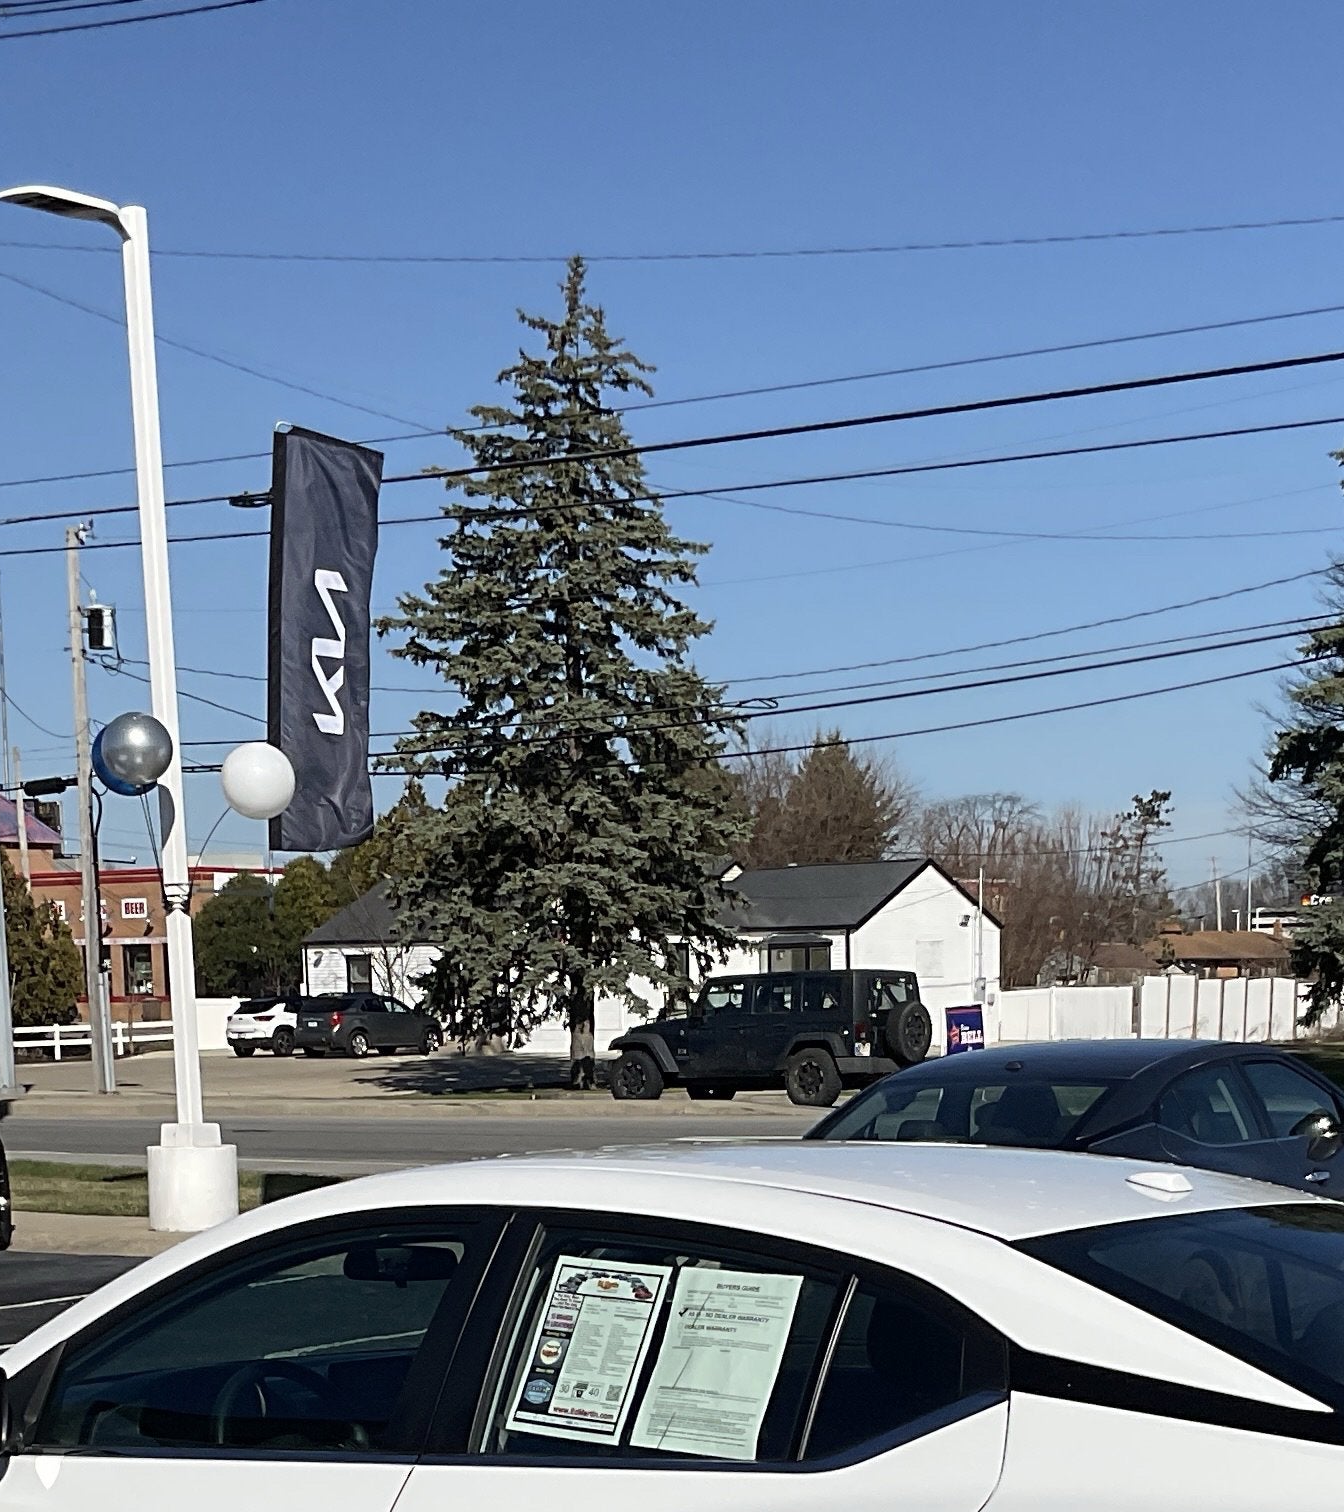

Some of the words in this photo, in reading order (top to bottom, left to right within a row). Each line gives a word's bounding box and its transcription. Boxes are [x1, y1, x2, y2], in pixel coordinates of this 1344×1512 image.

[124, 902, 145, 915] BEER
[960, 1030, 984, 1045] BELL
[559, 1384, 570, 1394] 30
[588, 1387, 600, 1397] 40
